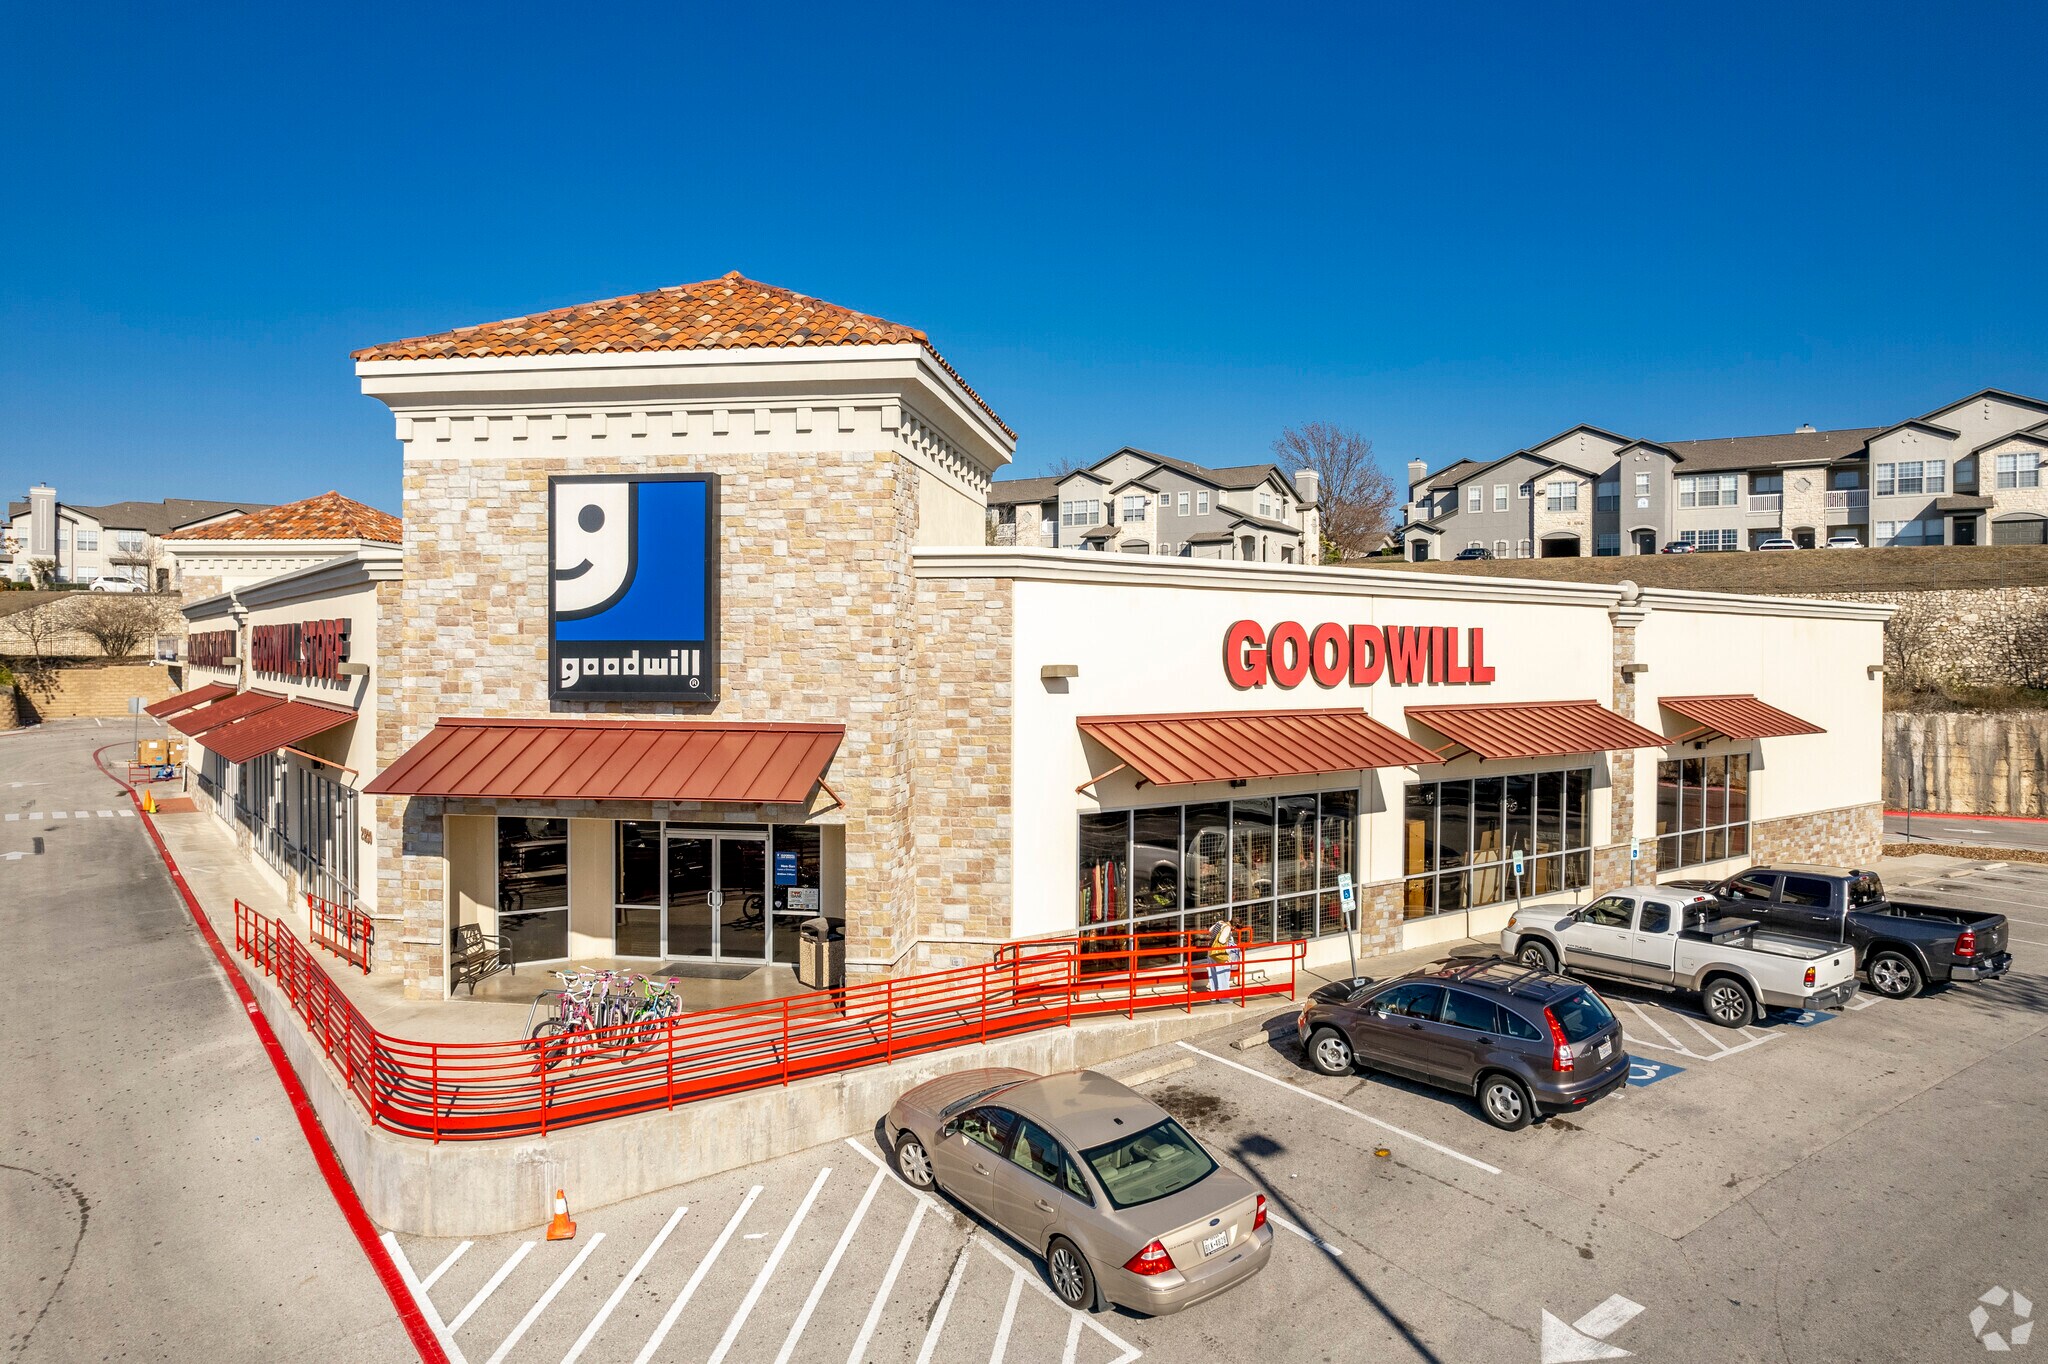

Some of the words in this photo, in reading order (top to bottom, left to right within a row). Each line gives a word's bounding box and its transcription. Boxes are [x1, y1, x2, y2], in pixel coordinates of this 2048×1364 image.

[301, 618, 350, 681] STORE
[561, 649, 700, 689] goodwill
[1224, 619, 1496, 689] GOODWILL
